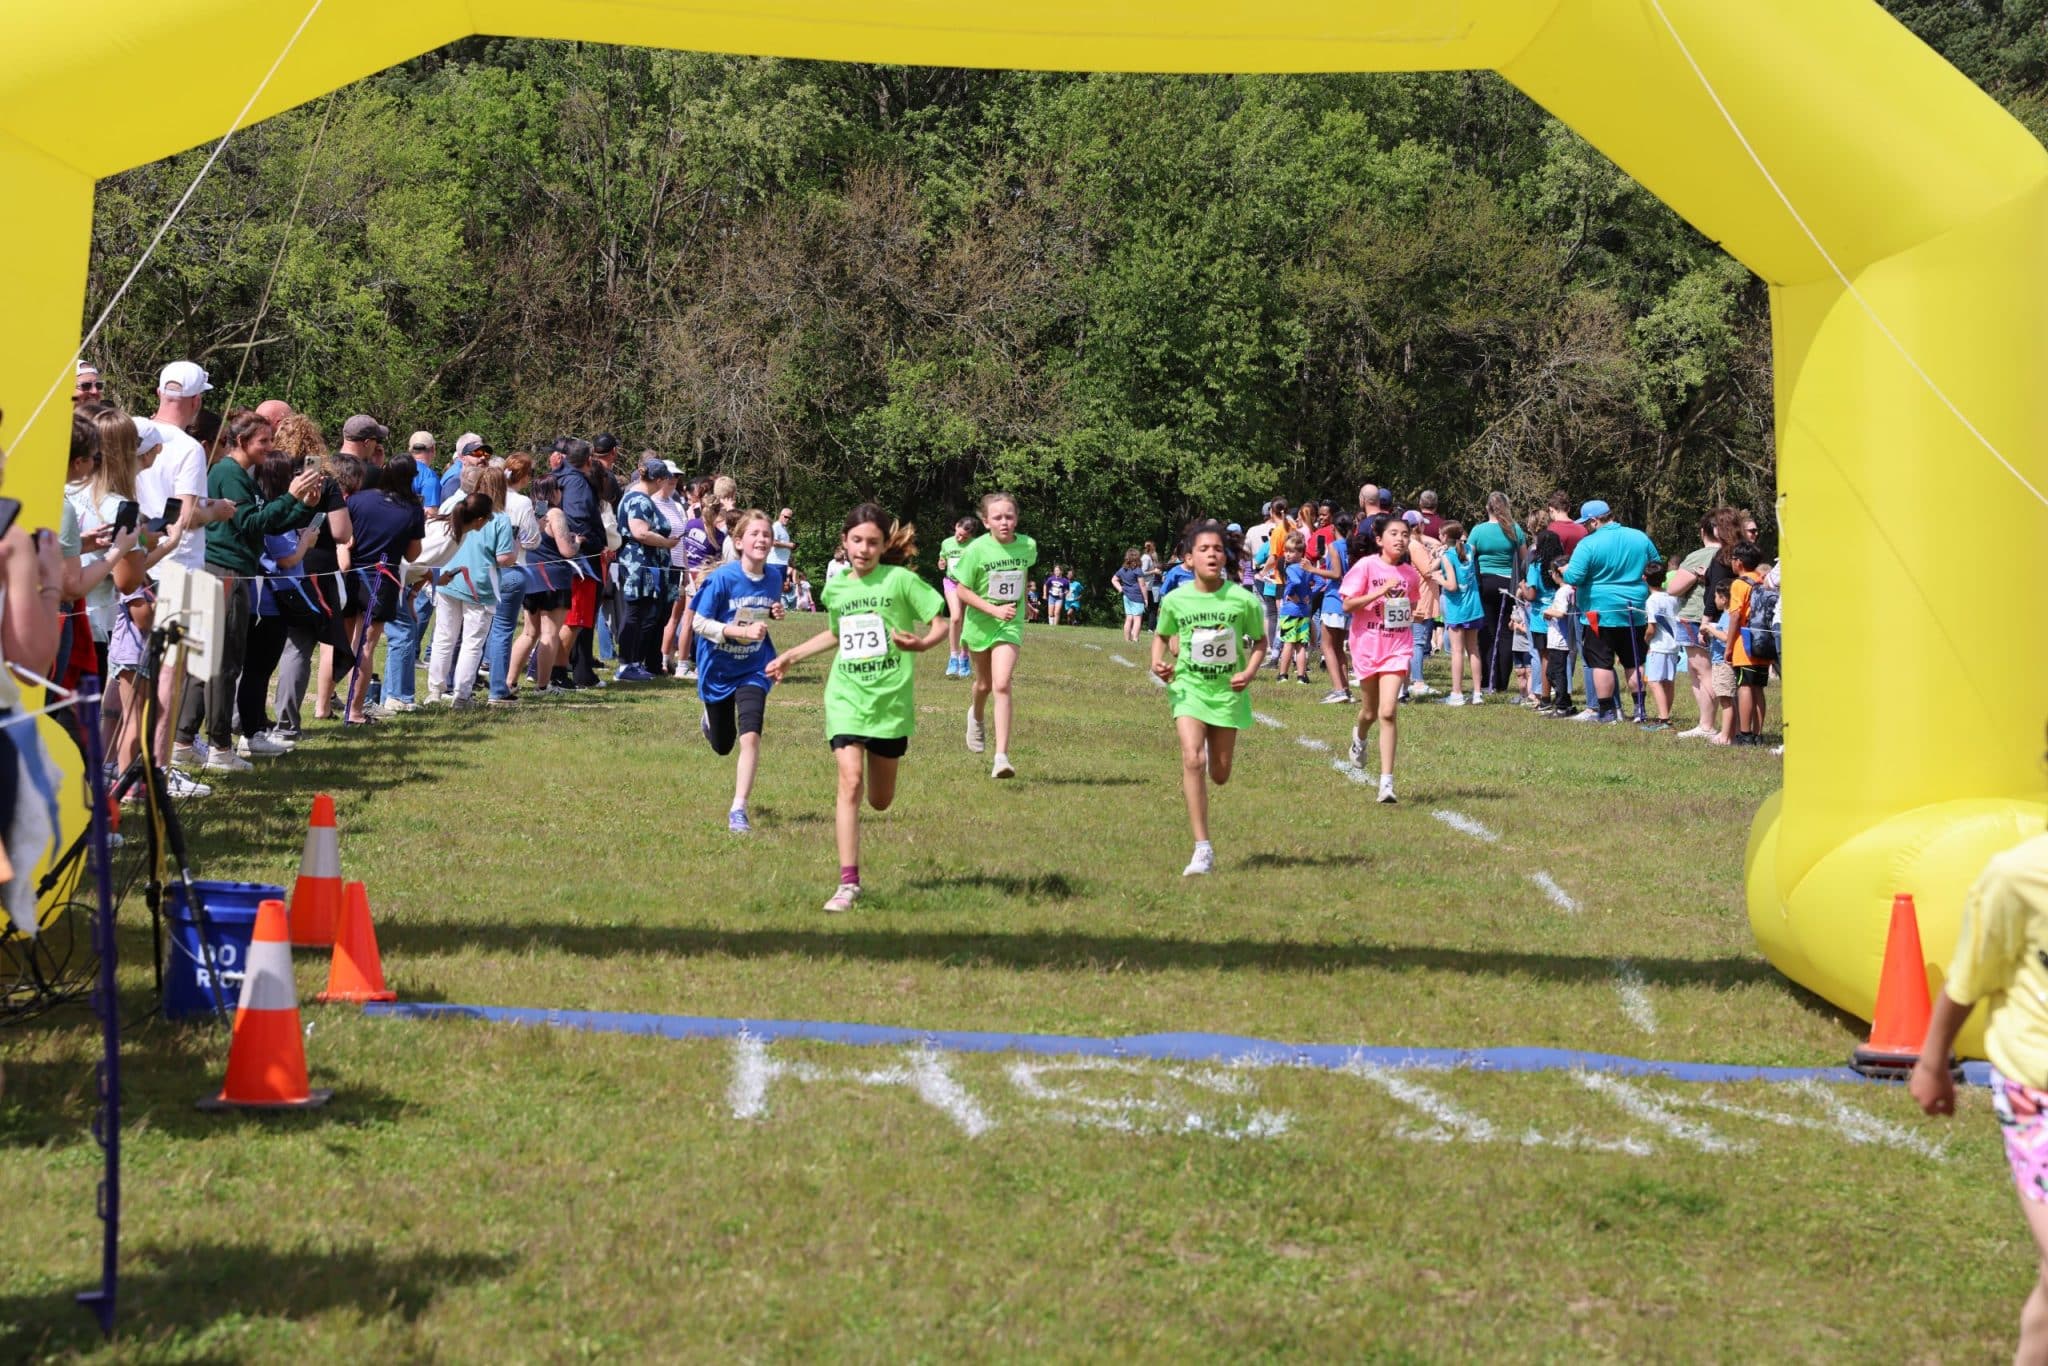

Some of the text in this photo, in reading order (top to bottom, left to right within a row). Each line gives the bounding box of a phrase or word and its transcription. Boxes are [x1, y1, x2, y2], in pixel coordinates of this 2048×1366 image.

[999, 583, 1014, 594] 81
[840, 597, 893, 616] UNNING IS
[1180, 612, 1238, 627] RUNNING IS
[1388, 610, 1410, 622] 530
[844, 631, 879, 650] 373
[1202, 643, 1227, 657] 86
[838, 656, 901, 674] ELEMENTARY
